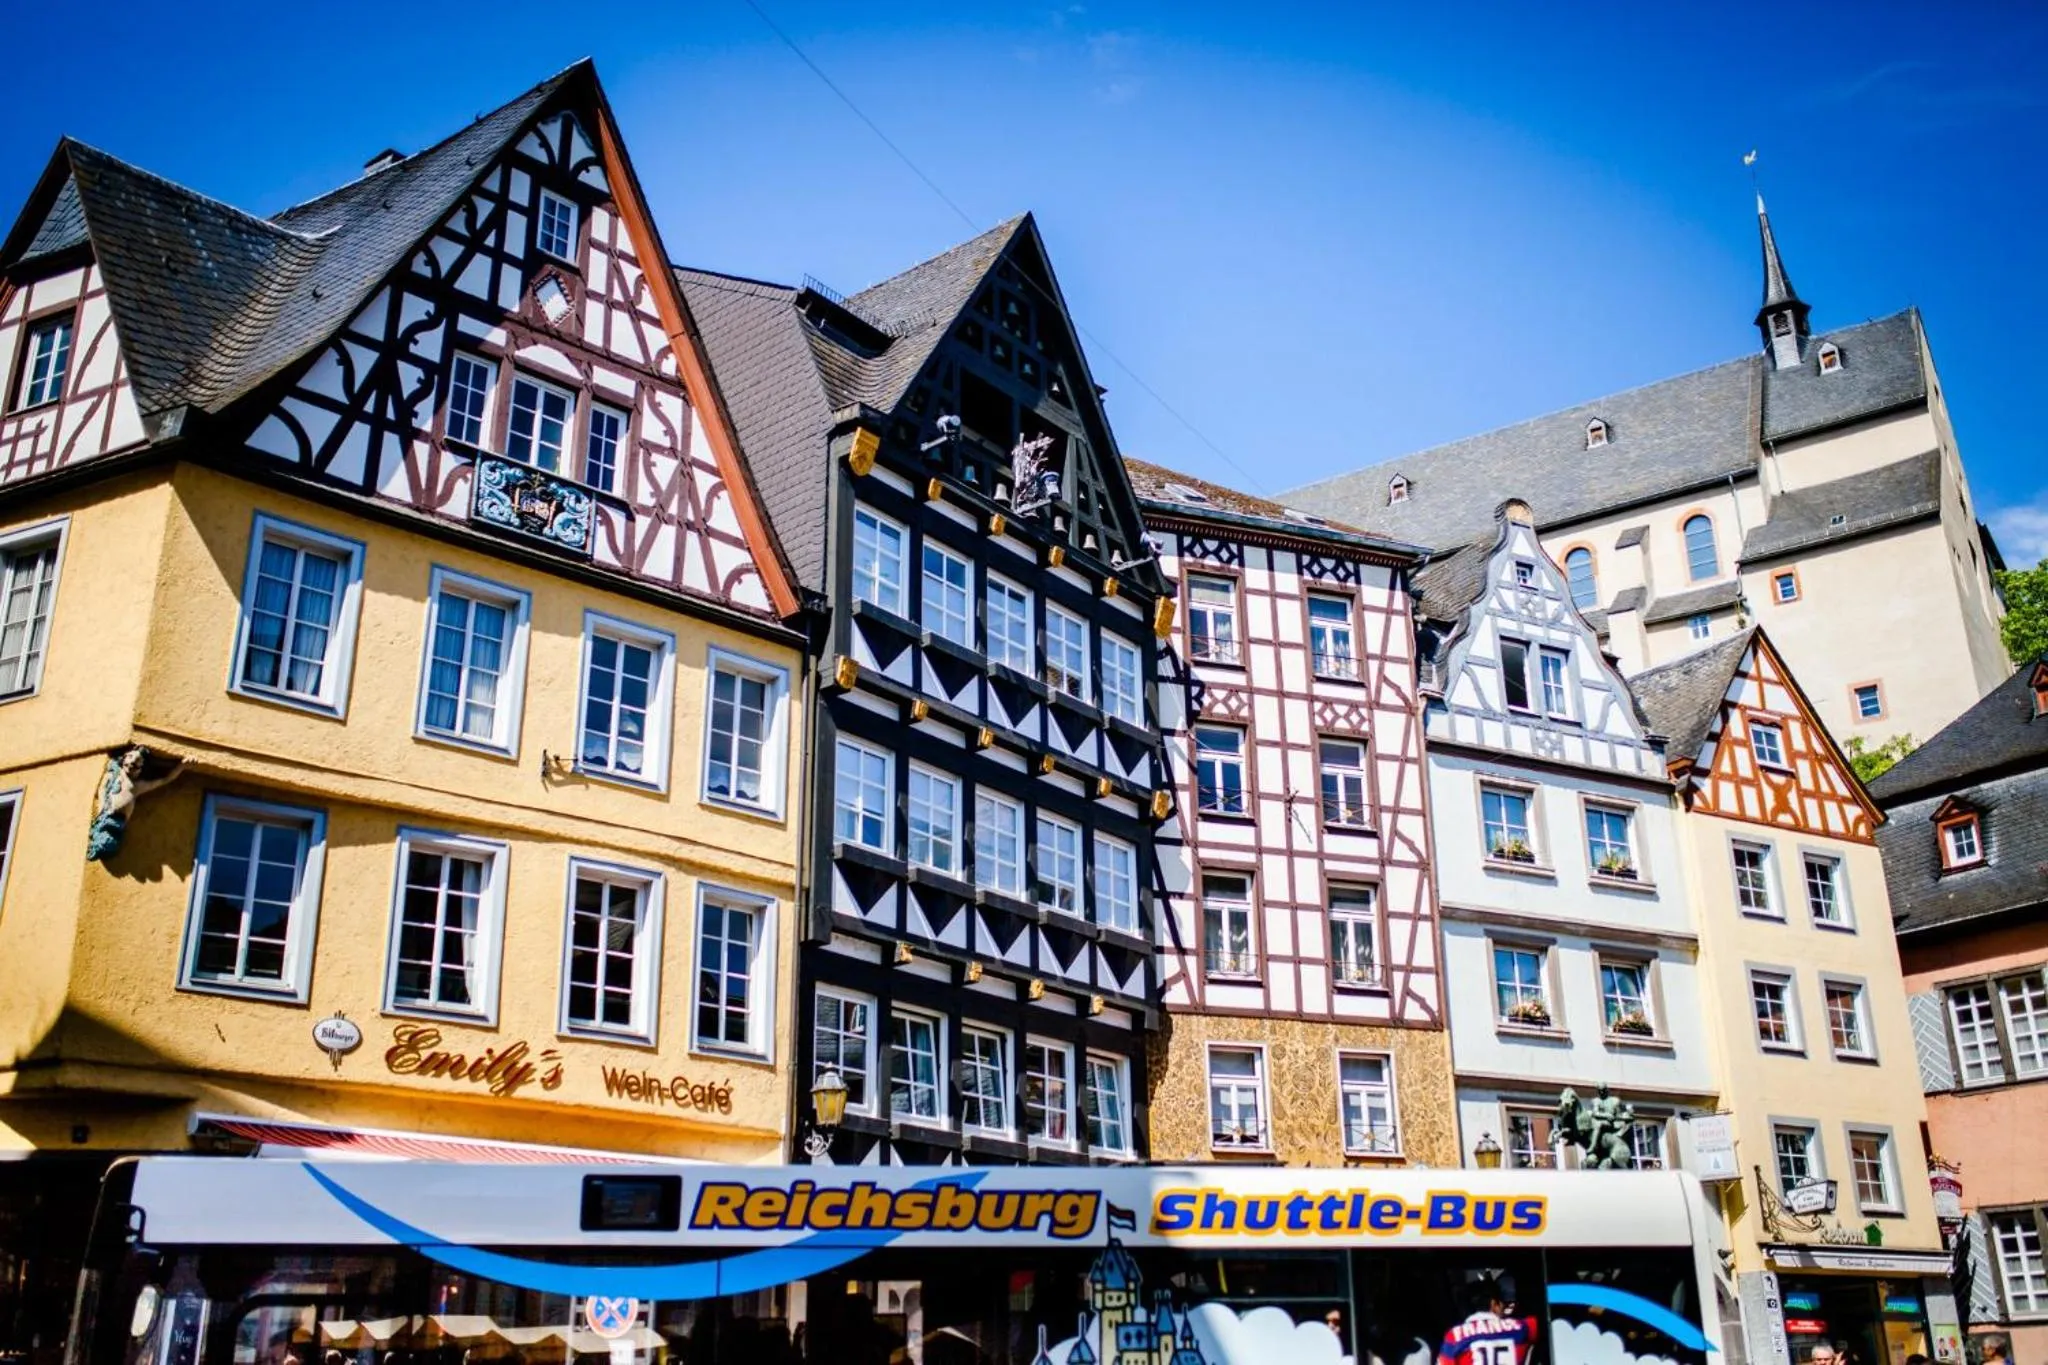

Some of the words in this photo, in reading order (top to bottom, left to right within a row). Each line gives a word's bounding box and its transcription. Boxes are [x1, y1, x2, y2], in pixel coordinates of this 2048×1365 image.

[384, 1024, 563, 1096] Emily's
[602, 1065, 732, 1112] Wein-Café
[688, 1180, 1102, 1240] Reichsburg
[1151, 1188, 1546, 1235] Shuttle-Bus
